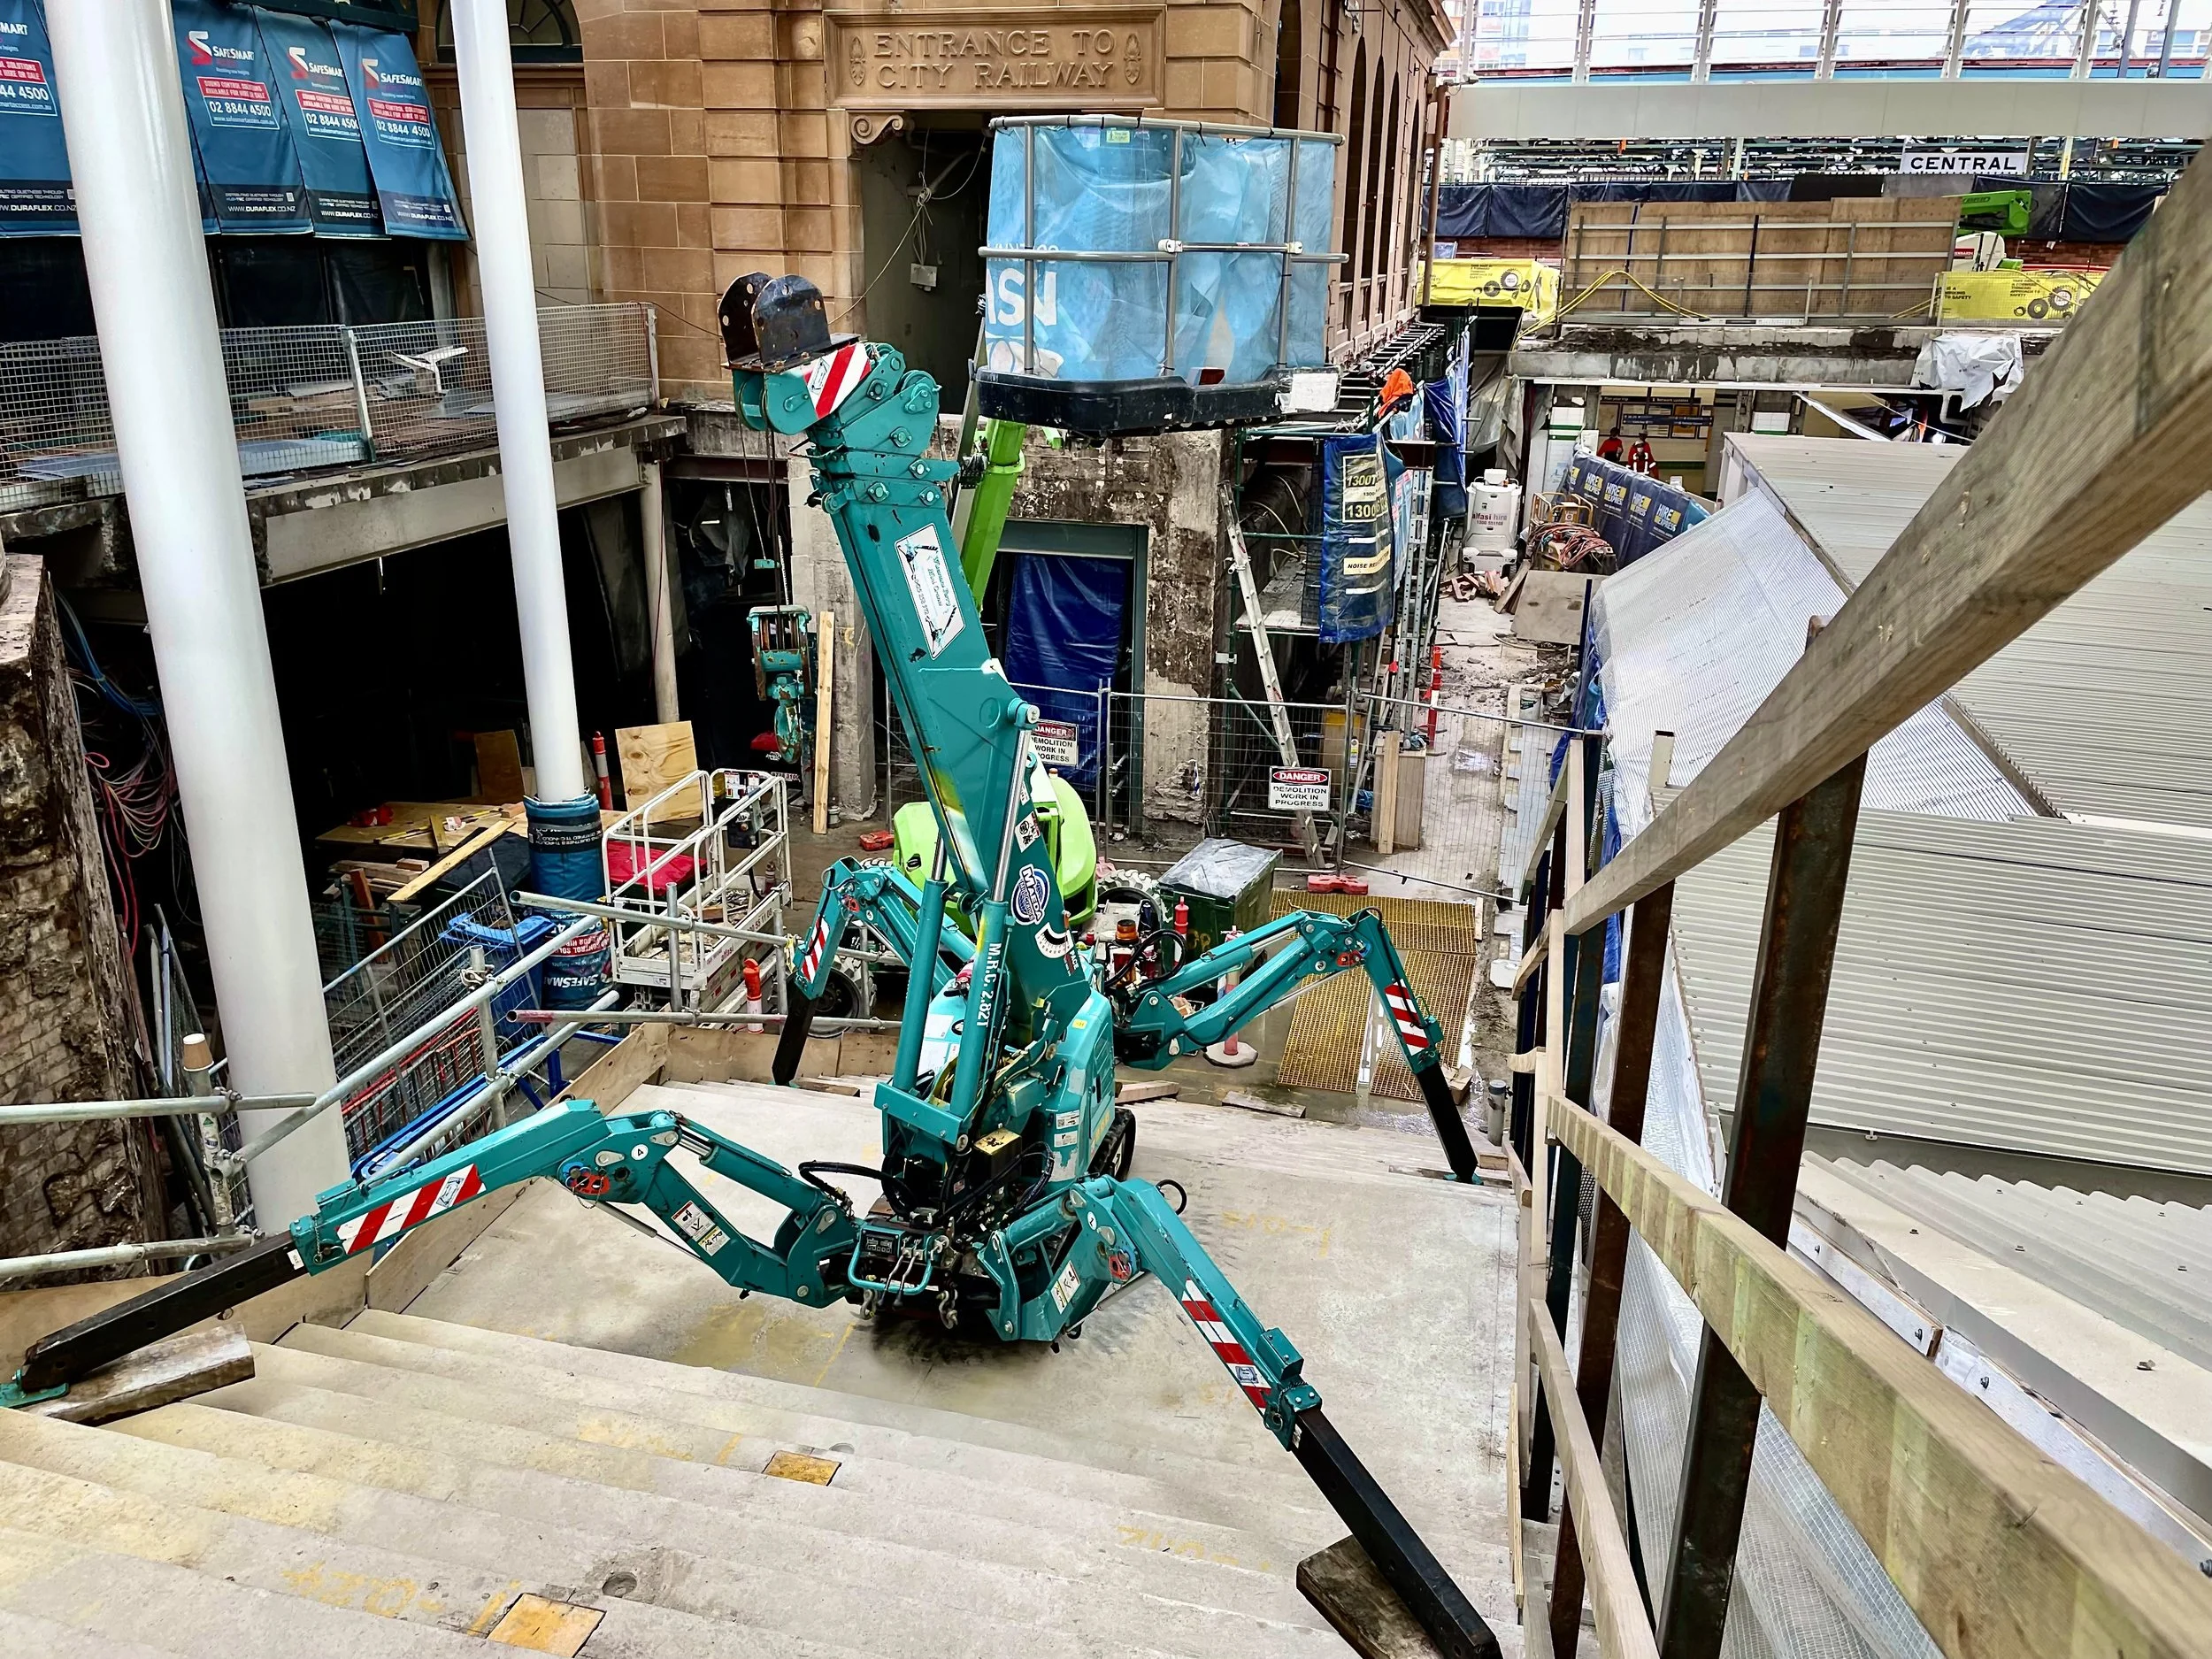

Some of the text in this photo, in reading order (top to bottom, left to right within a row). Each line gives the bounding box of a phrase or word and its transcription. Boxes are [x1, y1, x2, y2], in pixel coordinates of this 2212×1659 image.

[0, 22, 27, 35] MART
[873, 28, 1116, 58] ENTRANCE TO
[309, 63, 343, 78] SAFESMAR
[877, 62, 1115, 88] CITY RAILWAY
[19, 86, 49, 101] 4500
[210, 101, 272, 117] 02 8844 4500
[305, 112, 319, 126] 02
[319, 114, 341, 127] 8844
[376, 119, 430, 138] 02 8844 4500
[1910, 157, 2017, 171] CENTRAL
[1606, 482, 1620, 496] HIRE
[1657, 503, 1673, 520] HIRE
[1032, 737, 1072, 748] EMOLITION
[1038, 753, 1070, 762] OGRESS
[1279, 772, 1321, 781] DANGER
[1021, 867, 1043, 922] MAEDA
[1069, 949, 1079, 970] PACE
[544, 974, 599, 988] SAFESMA
[977, 943, 1002, 1027] M.R.C. 2.82T
